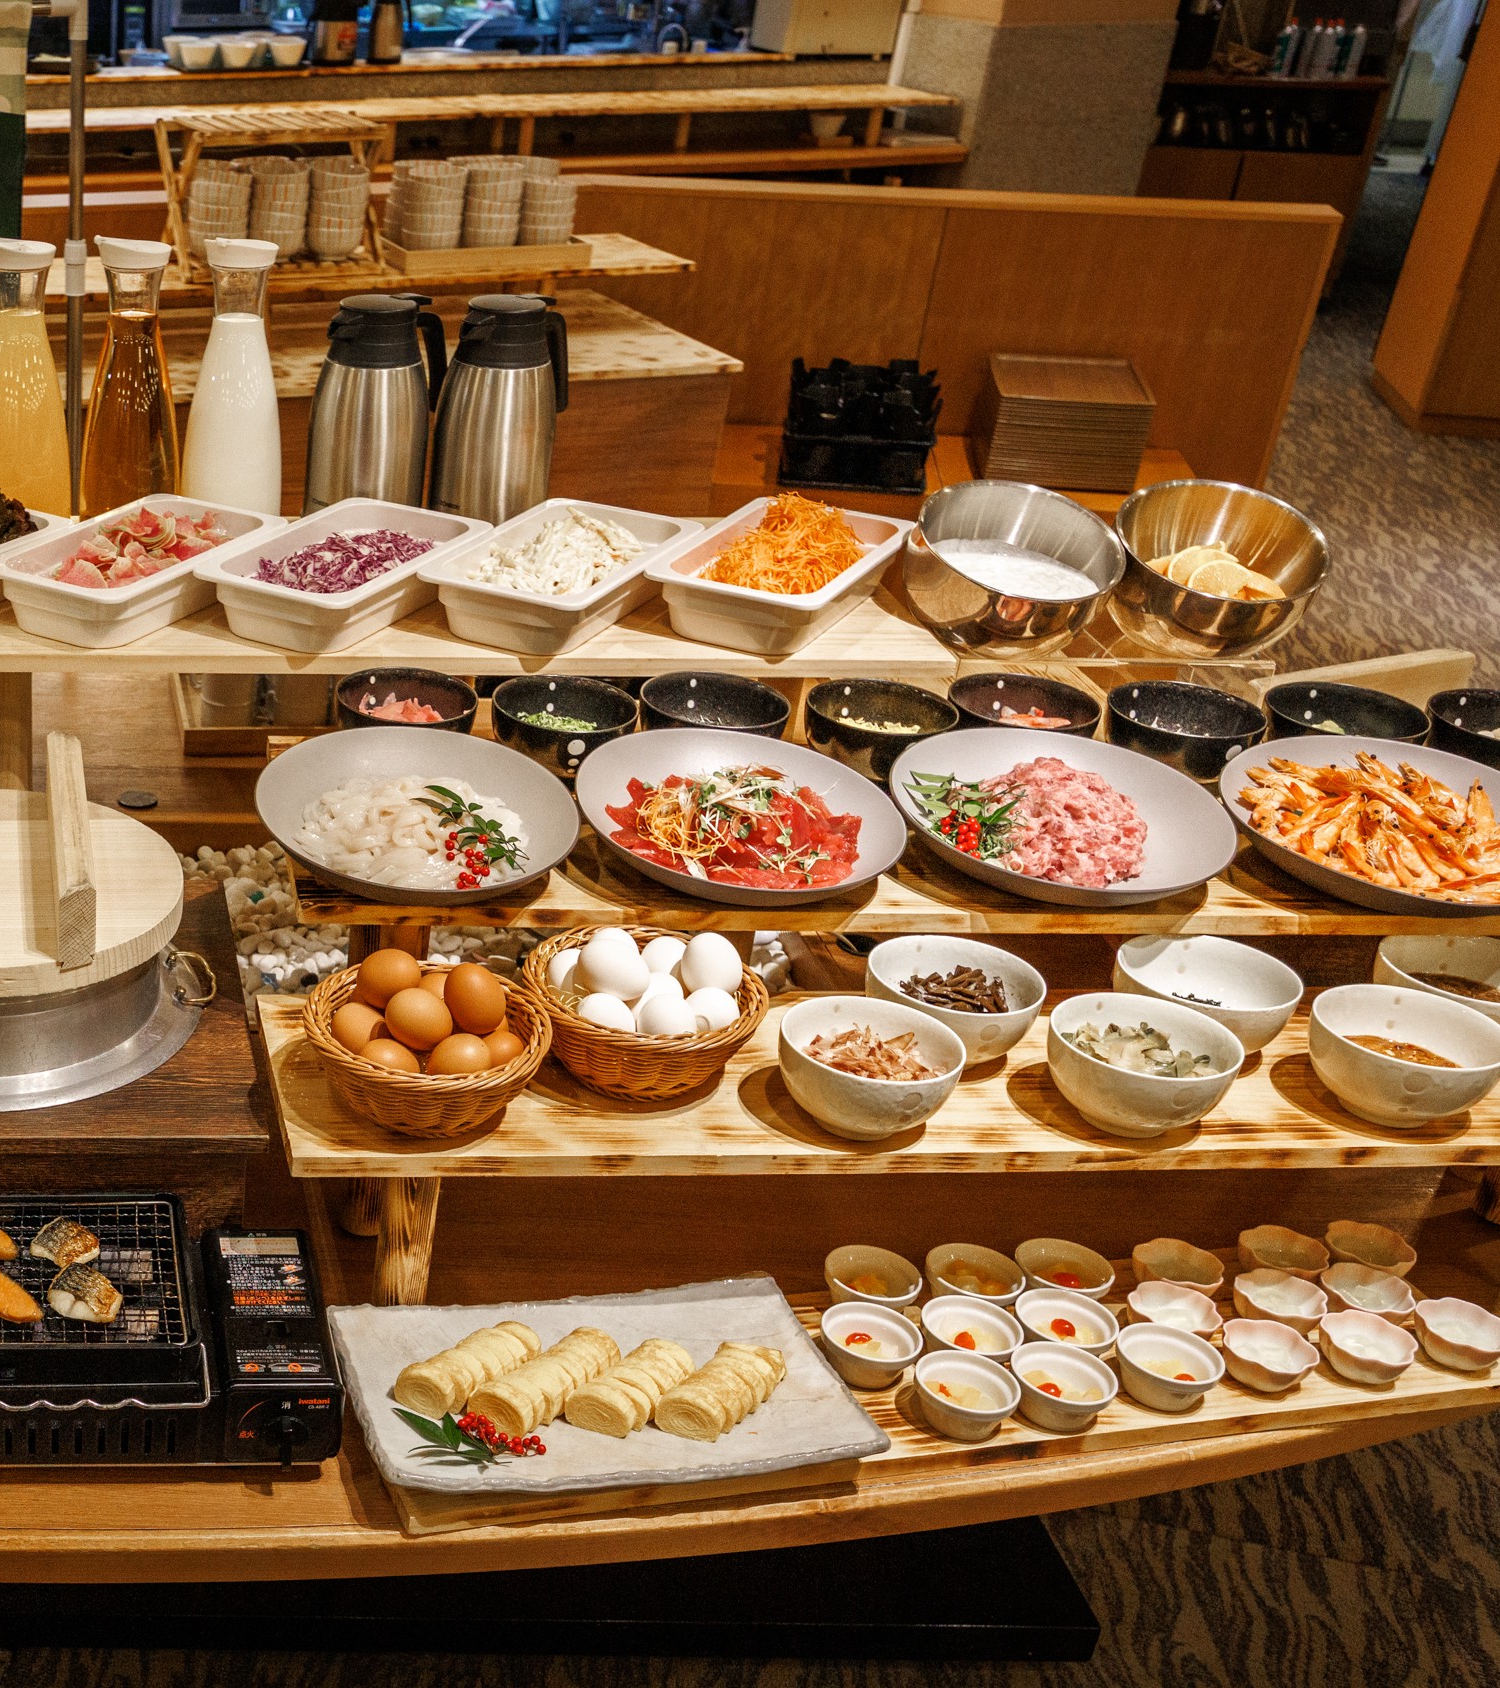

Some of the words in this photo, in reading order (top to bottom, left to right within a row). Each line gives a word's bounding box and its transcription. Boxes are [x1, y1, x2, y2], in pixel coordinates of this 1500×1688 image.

[280, 1401, 291, 1410] 消
[298, 1397, 331, 1405] iwatani
[238, 1429, 255, 1439] 点火
